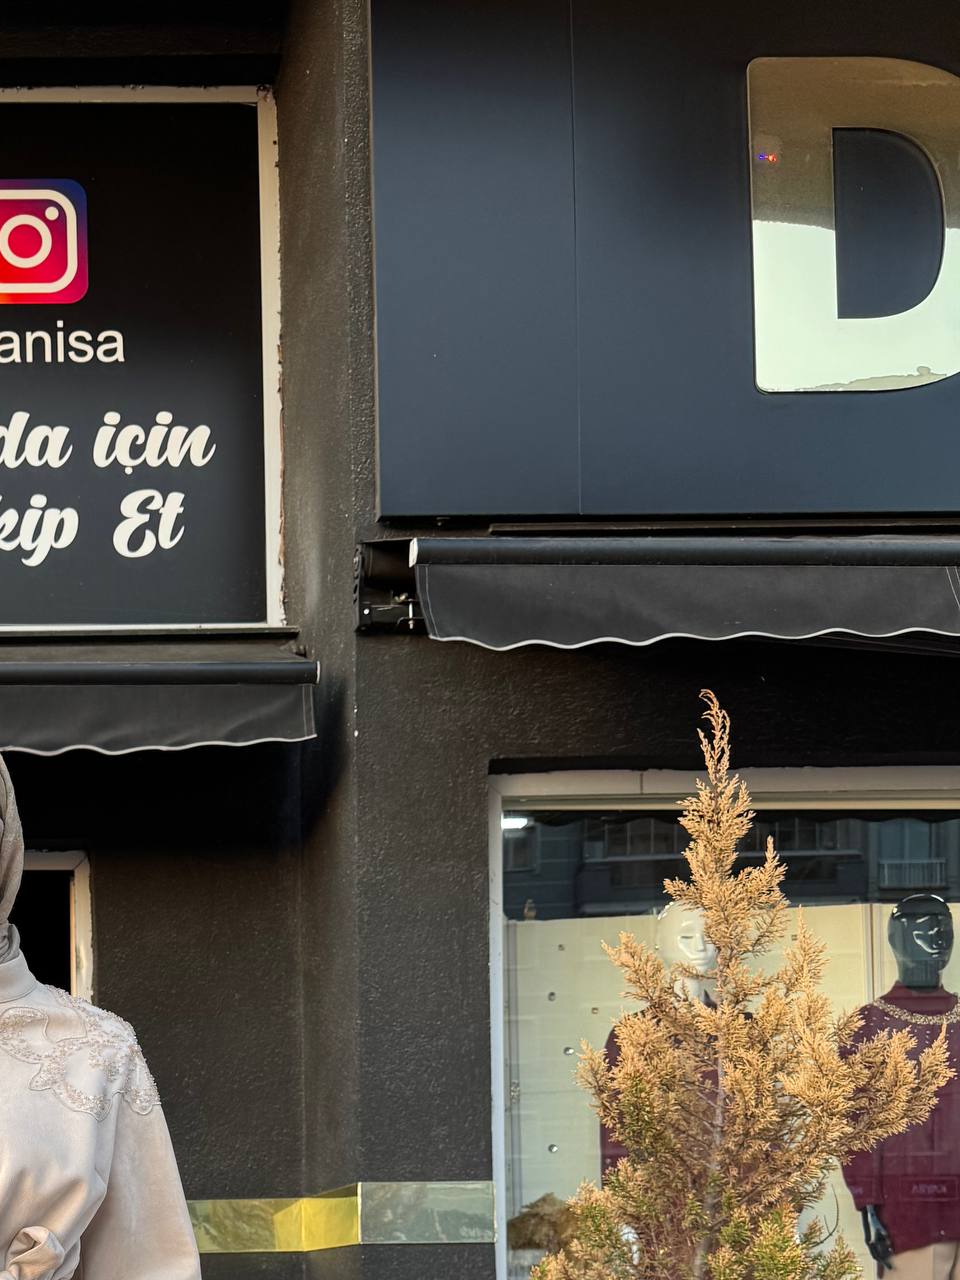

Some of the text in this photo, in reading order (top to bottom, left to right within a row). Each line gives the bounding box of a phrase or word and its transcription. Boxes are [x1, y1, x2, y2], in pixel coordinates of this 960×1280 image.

[746, 56, 960, 394] D
[92, 411, 216, 475] için
[113, 489, 185, 557] Et
